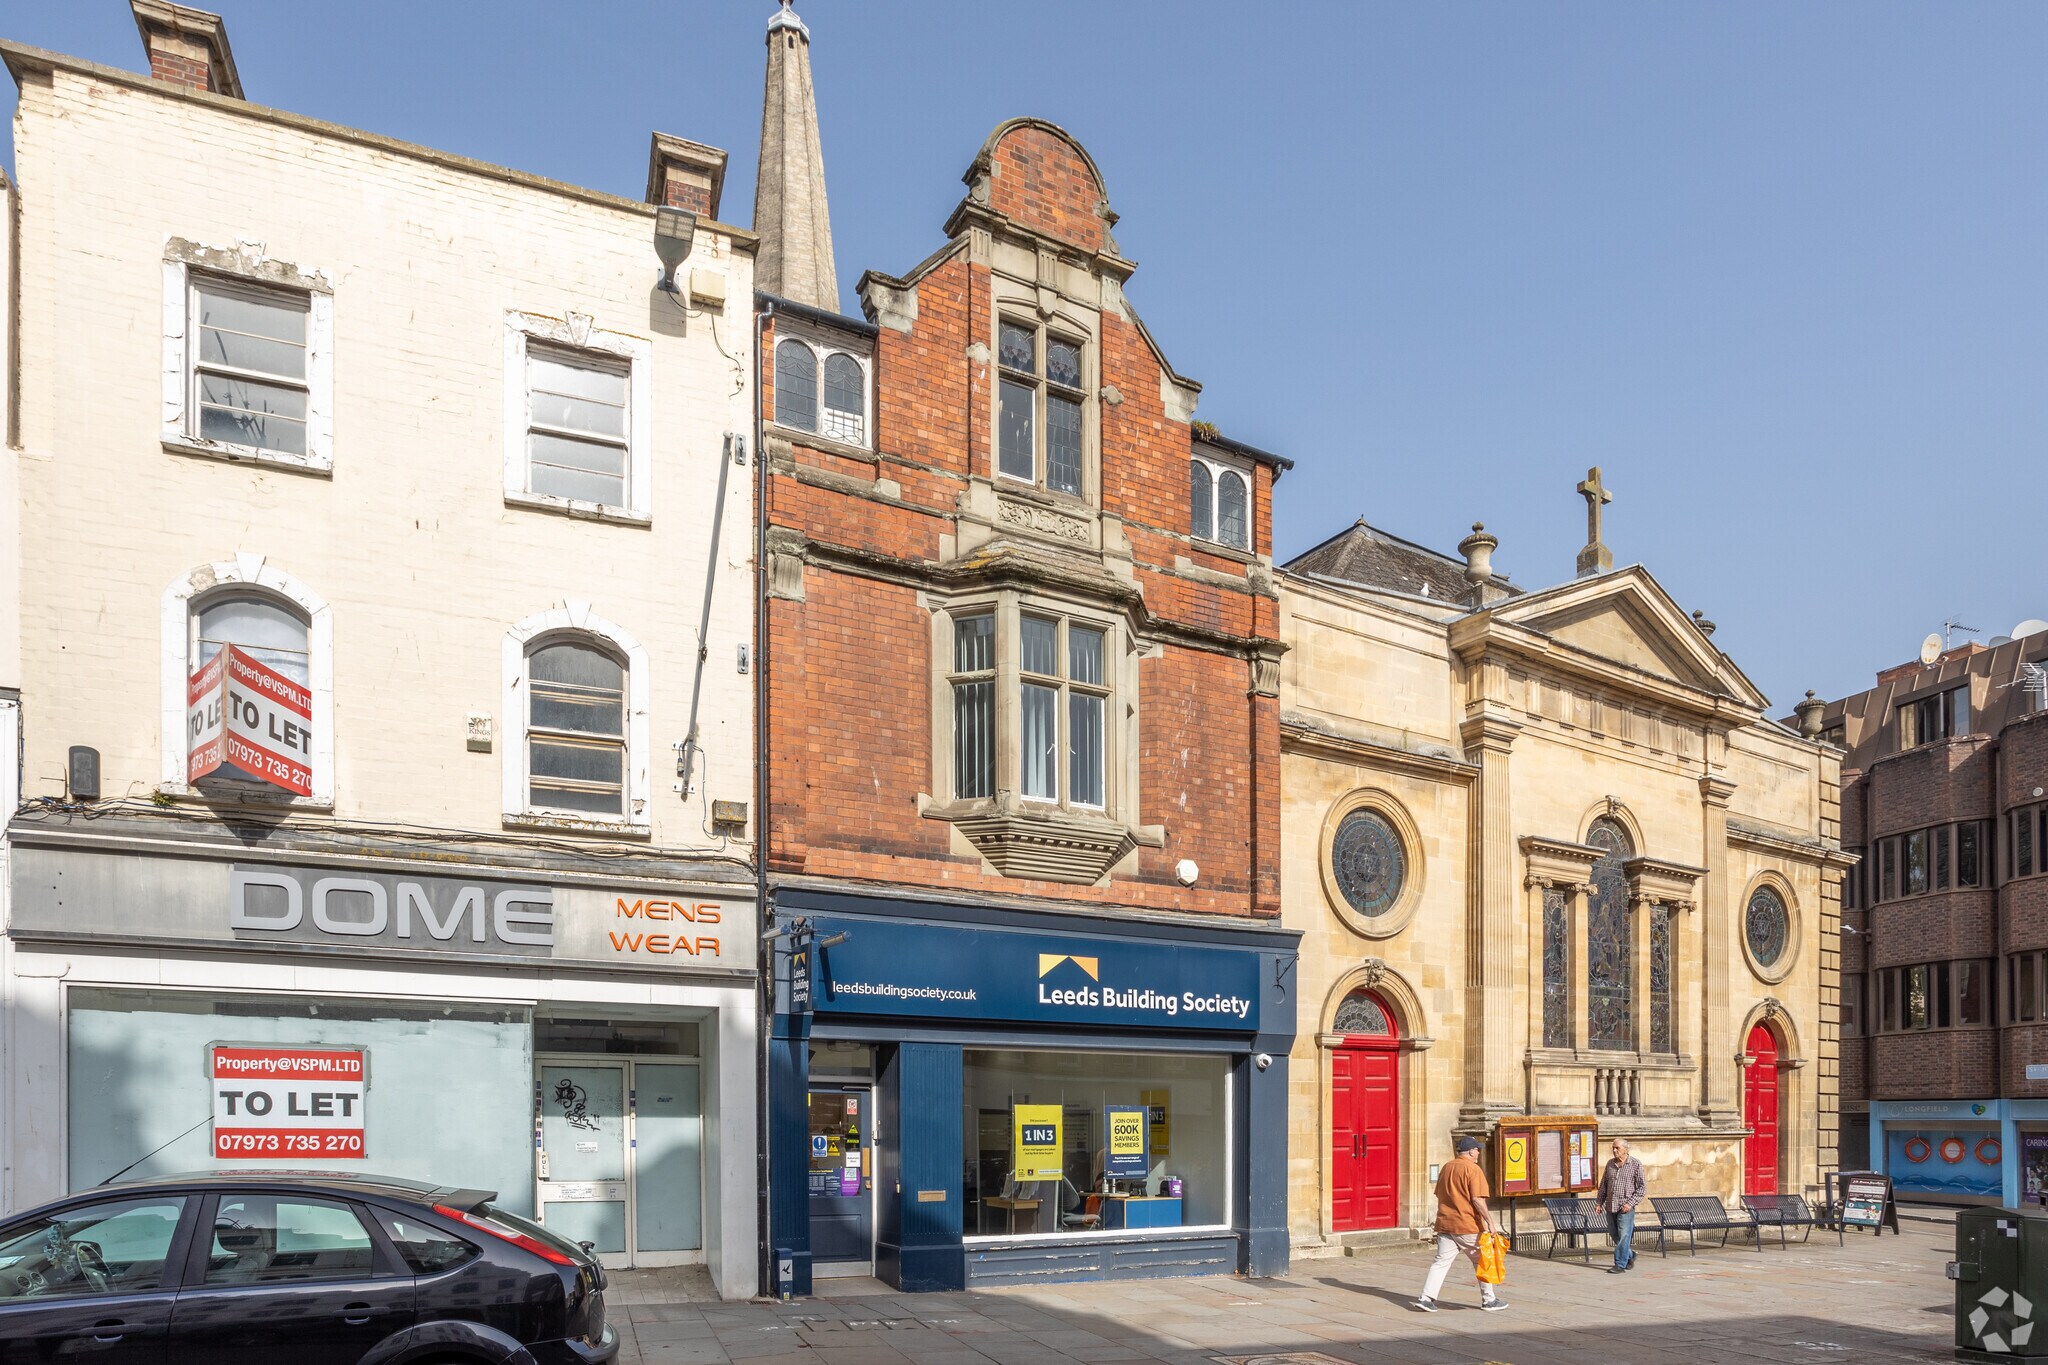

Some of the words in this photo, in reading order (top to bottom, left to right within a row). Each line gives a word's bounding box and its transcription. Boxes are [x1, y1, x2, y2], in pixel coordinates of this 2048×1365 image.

[229, 652, 312, 711] Property@VSPM.LTD
[207, 697, 223, 730] LE
[230, 690, 260, 730] TO
[268, 711, 312, 755] LET
[468, 727, 491, 736] KINGS
[228, 737, 263, 769] 07973
[265, 756, 290, 780] 735
[291, 768, 312, 790] 270
[231, 870, 554, 946] DOME
[617, 898, 721, 924] MENS
[609, 931, 720, 957] WEAR
[793, 967, 806, 979] Leeds
[793, 979, 809, 991] Building
[832, 980, 977, 1002] leedsbuildingsociety.co.uk
[793, 991, 809, 1003] Society
[1038, 983, 1100, 1007] Leeds
[1102, 987, 1178, 1016] Building
[1182, 991, 1251, 1019] Society
[216, 1056, 361, 1073] Property@VSPM.LTD
[219, 1090, 273, 1117] TO
[288, 1091, 359, 1117] LET
[1904, 1105, 1949, 1113] LONGFIELD
[1159, 1111, 1164, 1120] 3
[1025, 1130, 1032, 1141] 1
[1033, 1129, 1046, 1141] IN
[1046, 1130, 1054, 1141] 3
[1114, 1125, 1139, 1135] 600K
[218, 1135, 279, 1151] 07973
[284, 1135, 321, 1151] 735
[325, 1135, 361, 1151] 270
